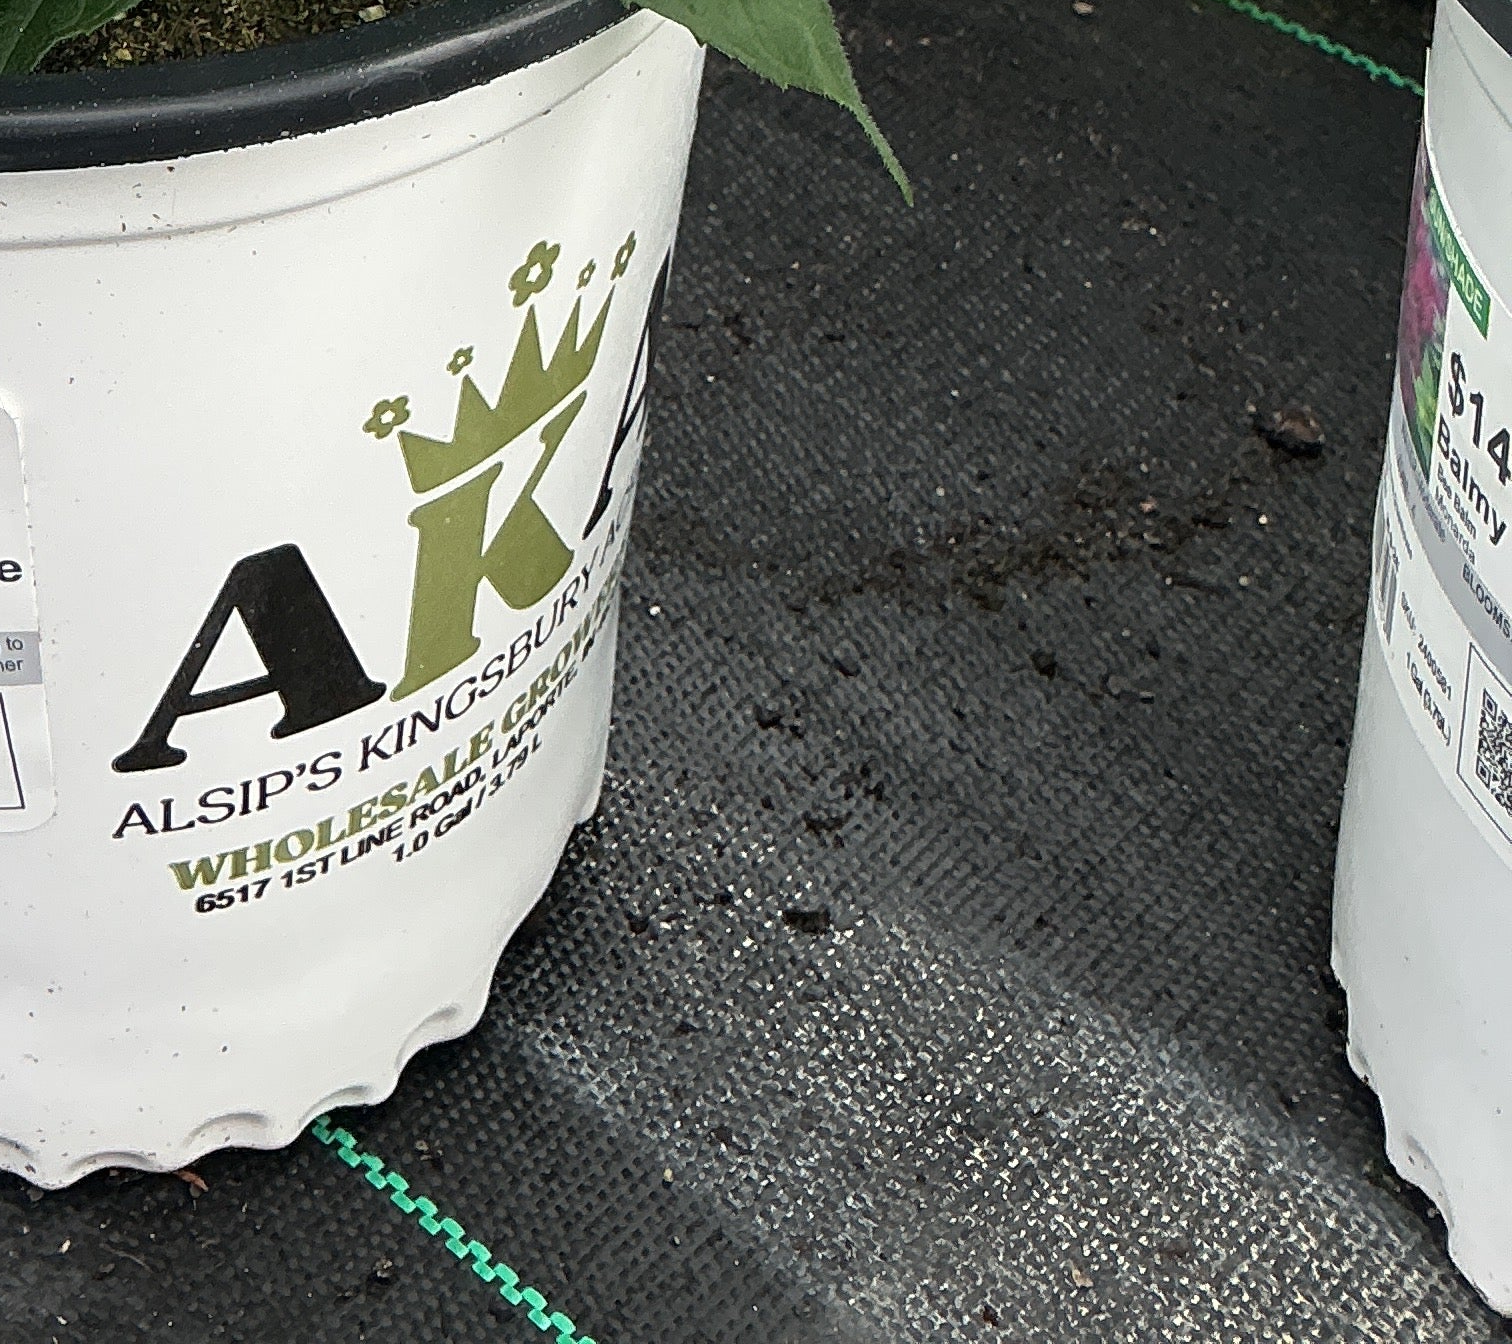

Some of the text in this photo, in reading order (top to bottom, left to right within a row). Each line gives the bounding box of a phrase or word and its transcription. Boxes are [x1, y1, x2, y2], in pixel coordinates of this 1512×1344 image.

[1438, 413, 1506, 546] Balmy
[6, 637, 24, 651] to
[112, 544, 599, 839] ALSIP'S KINGSBURY
[168, 719, 495, 891] WHOLESALE
[195, 876, 271, 913] 6517
[281, 851, 336, 888] 1ST
[340, 817, 404, 867] LINE
[409, 765, 487, 829] ROAD,
[392, 830, 429, 863] 1.0
[434, 797, 473, 838] Gal
[488, 745, 528, 797] 3.79
